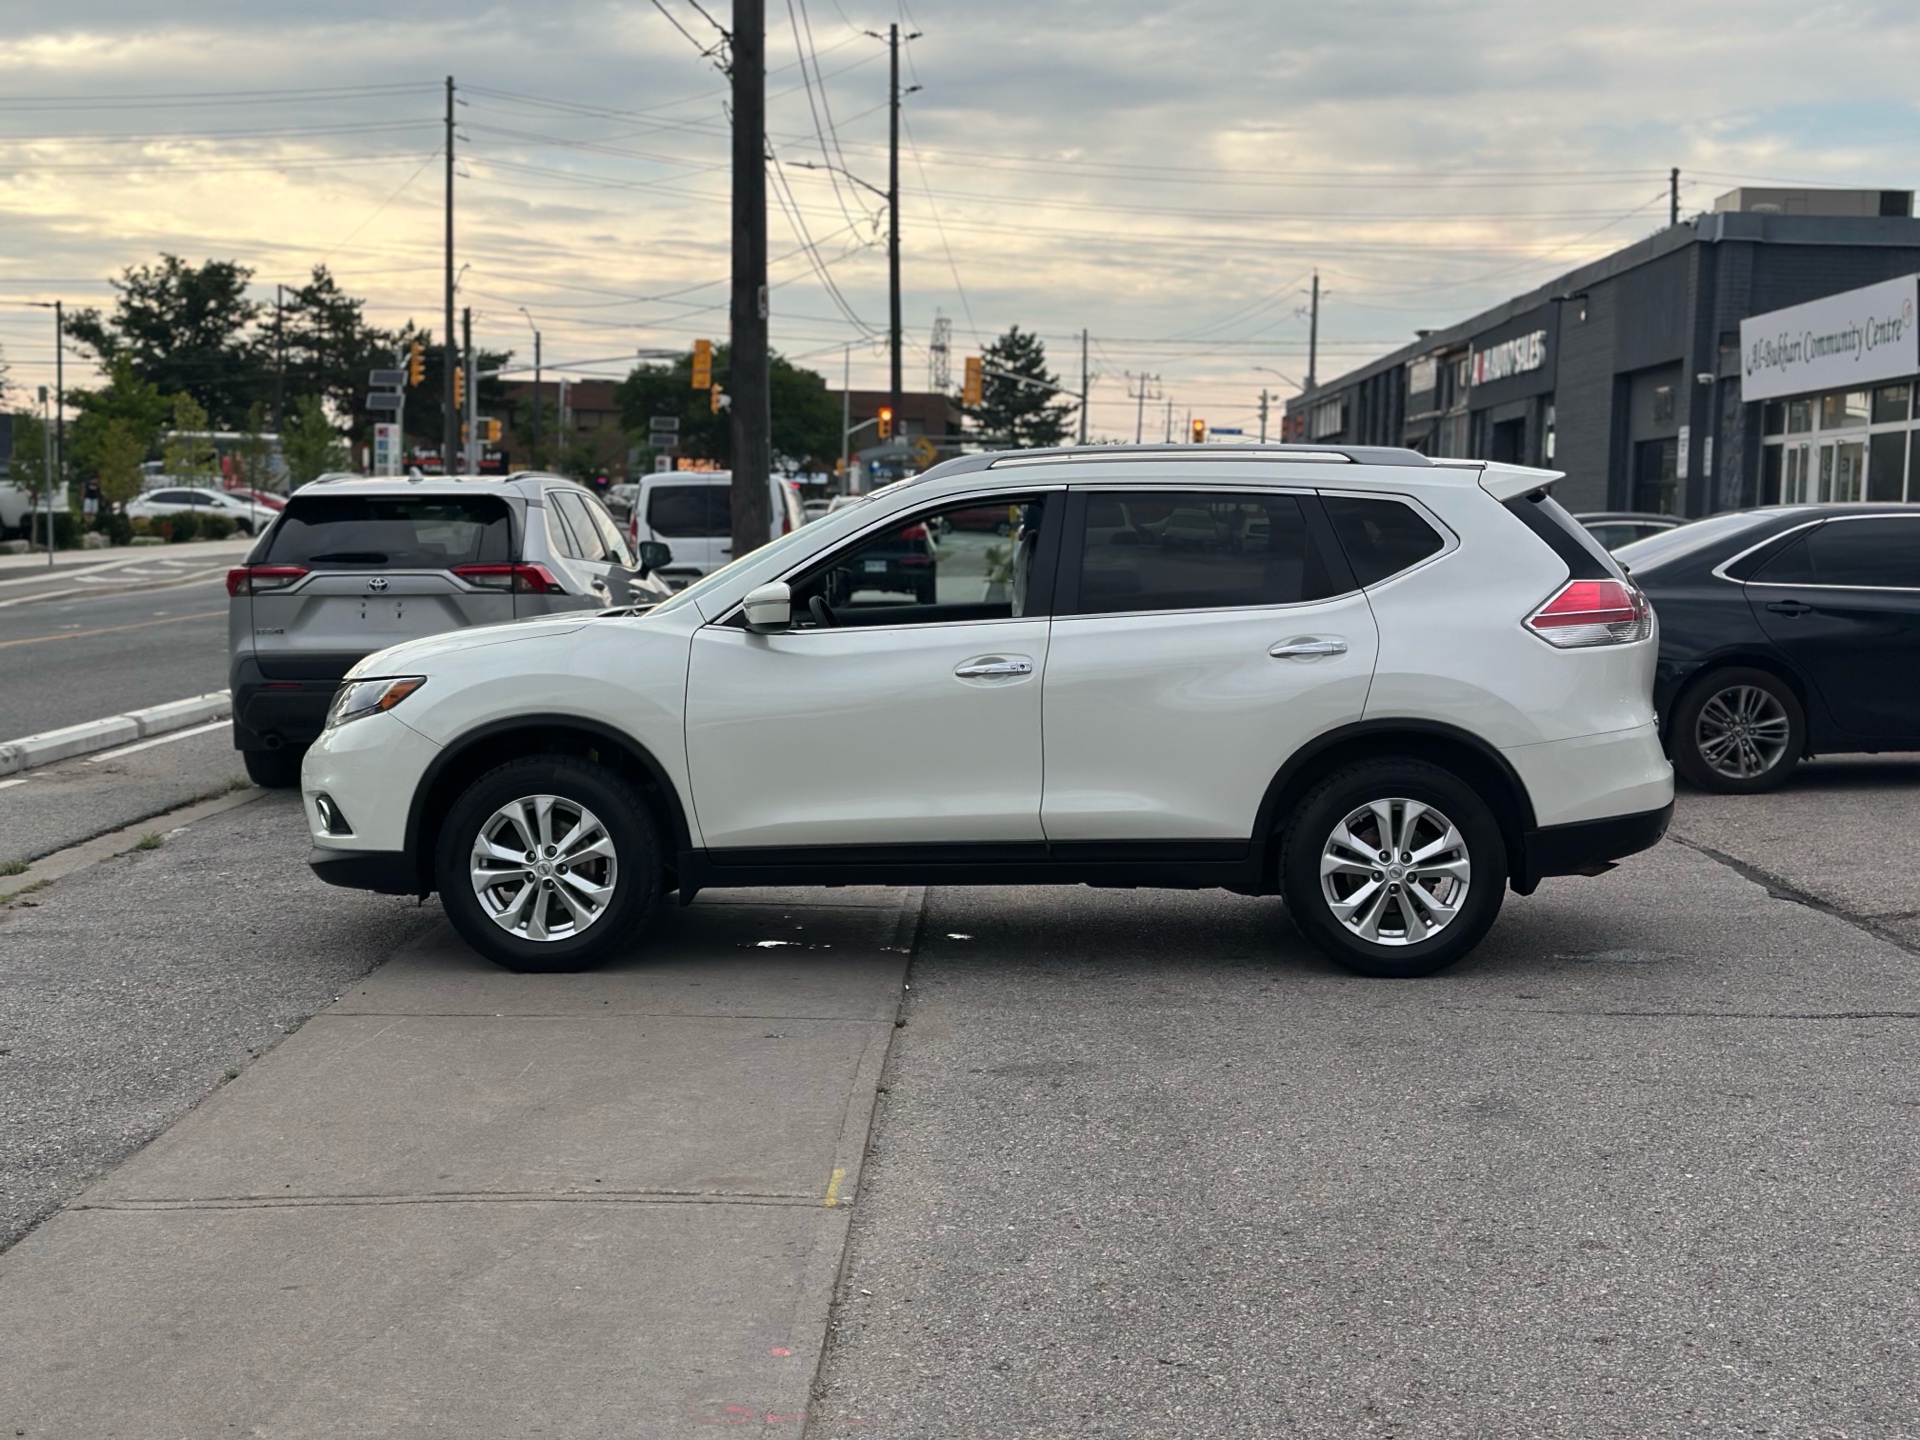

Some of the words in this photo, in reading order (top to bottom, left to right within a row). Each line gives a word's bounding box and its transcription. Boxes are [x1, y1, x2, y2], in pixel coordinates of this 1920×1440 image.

[1514, 330, 1547, 375] SALES
[1746, 332, 1803, 376] Al-Bukhari
[1804, 320, 1863, 362] Community
[1866, 316, 1902, 351] Centre
